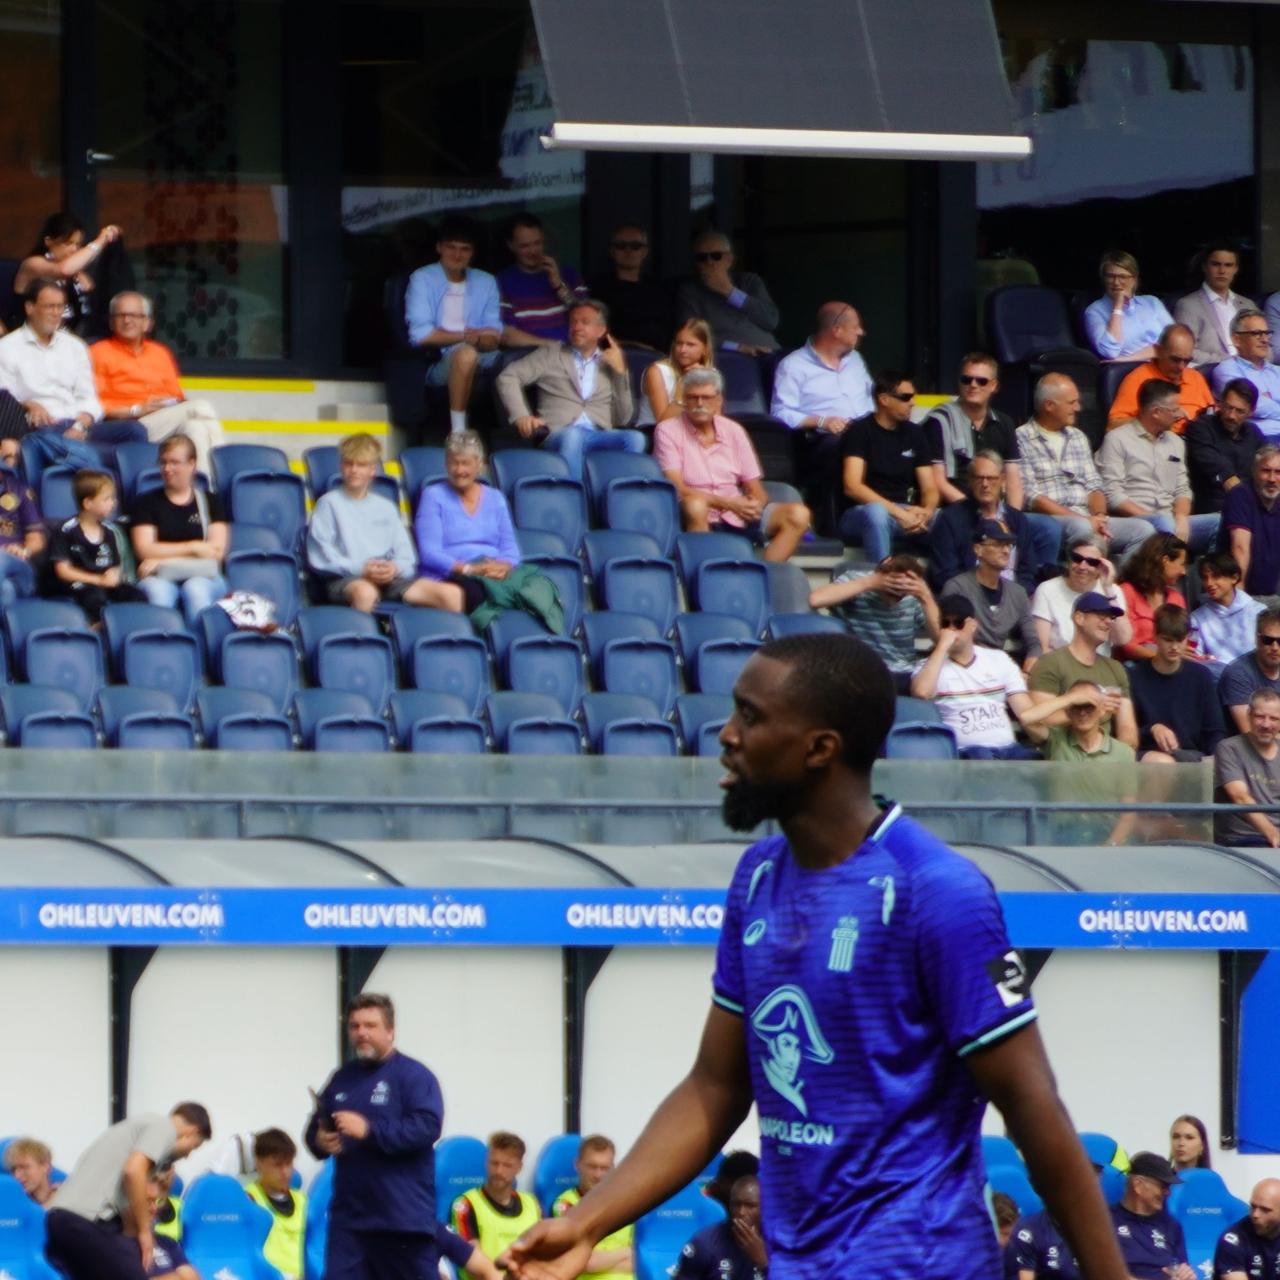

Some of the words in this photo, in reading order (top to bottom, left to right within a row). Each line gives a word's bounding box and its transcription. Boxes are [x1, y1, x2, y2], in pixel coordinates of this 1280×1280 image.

[39, 902, 224, 929] OHLEUVEN.COM
[304, 903, 486, 929] OHLEUVEN.COM
[566, 902, 724, 929] OHLEUVEN.CO
[1078, 908, 1248, 932] OHLEUVEN.COM
